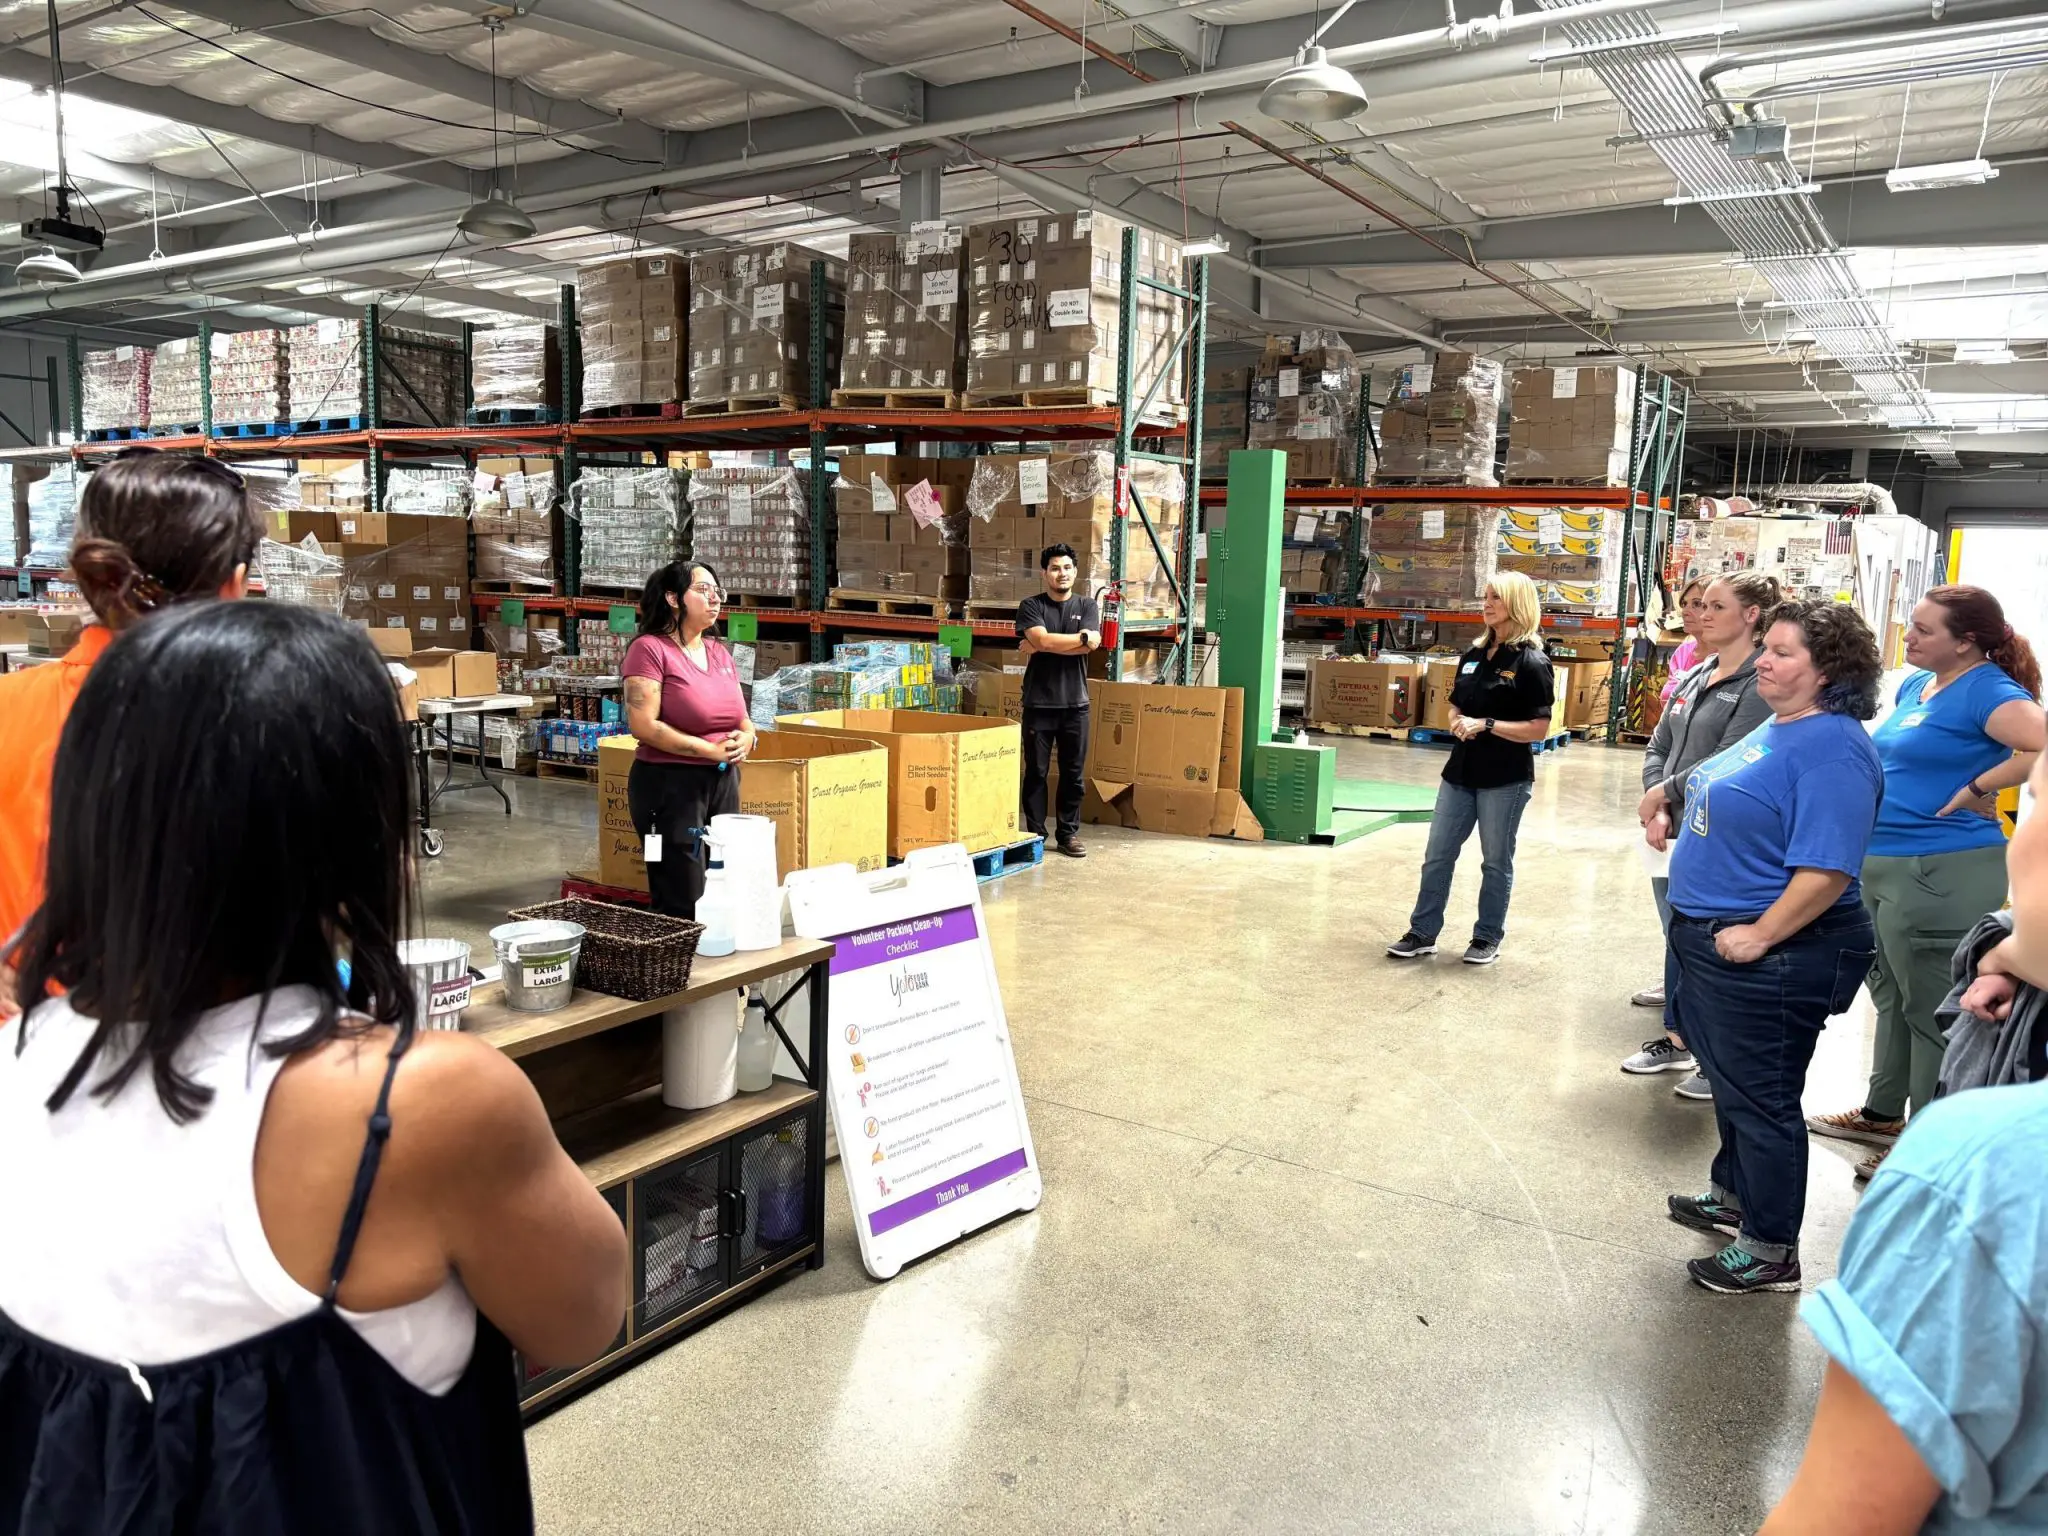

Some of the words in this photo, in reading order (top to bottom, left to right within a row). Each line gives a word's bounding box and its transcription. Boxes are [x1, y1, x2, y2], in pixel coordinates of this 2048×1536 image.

[993, 281, 1037, 304] FOOD
[1004, 301, 1054, 332] BANK
[1004, 697, 1022, 707] Dur
[1144, 703, 1164, 713] Durst
[1165, 705, 1188, 717] Organic
[1191, 707, 1216, 718] Growers
[605, 780, 628, 794] Dur
[812, 786, 832, 798] Durst
[833, 783, 857, 797] Organic
[859, 779, 882, 794] Growers
[750, 801, 763, 809] Red
[764, 800, 793, 808] Seedless
[765, 808, 789, 816] Seeded
[605, 812, 633, 827] Grow
[613, 838, 629, 856] Jim
[851, 930, 886, 947] Volunteer
[886, 923, 914, 938] Packing
[913, 916, 943, 931] Clean-Up
[886, 939, 919, 956] Checklist
[534, 964, 562, 975] EXTRA
[534, 974, 563, 986] LARGE
[434, 990, 467, 1007] LARGE
[936, 1185, 957, 1205] Thank
[956, 1182, 970, 1196] You
